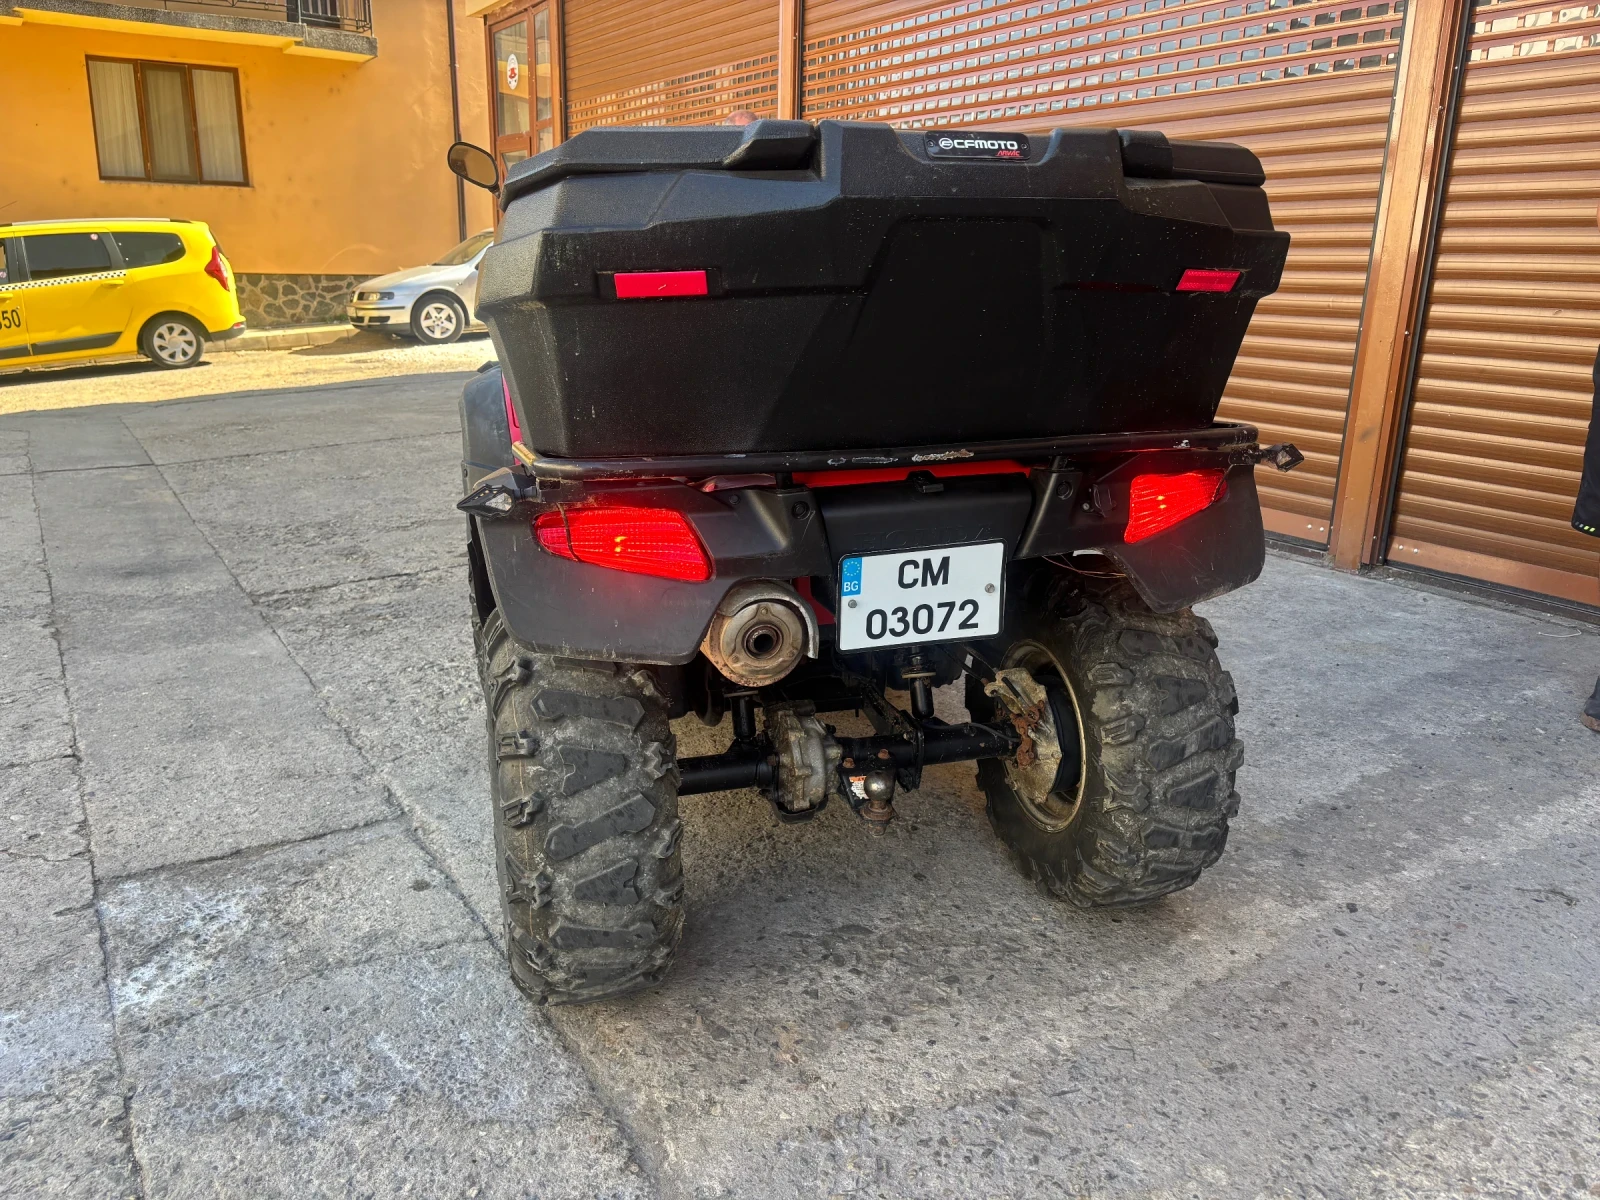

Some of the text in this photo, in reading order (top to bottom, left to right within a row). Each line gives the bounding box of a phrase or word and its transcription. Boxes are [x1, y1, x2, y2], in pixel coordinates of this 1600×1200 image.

[953, 139, 1018, 150] CFMOTO
[0, 309, 21, 330] 50
[897, 556, 951, 589] CM
[843, 581, 859, 592] BG
[865, 598, 980, 640] 03072
